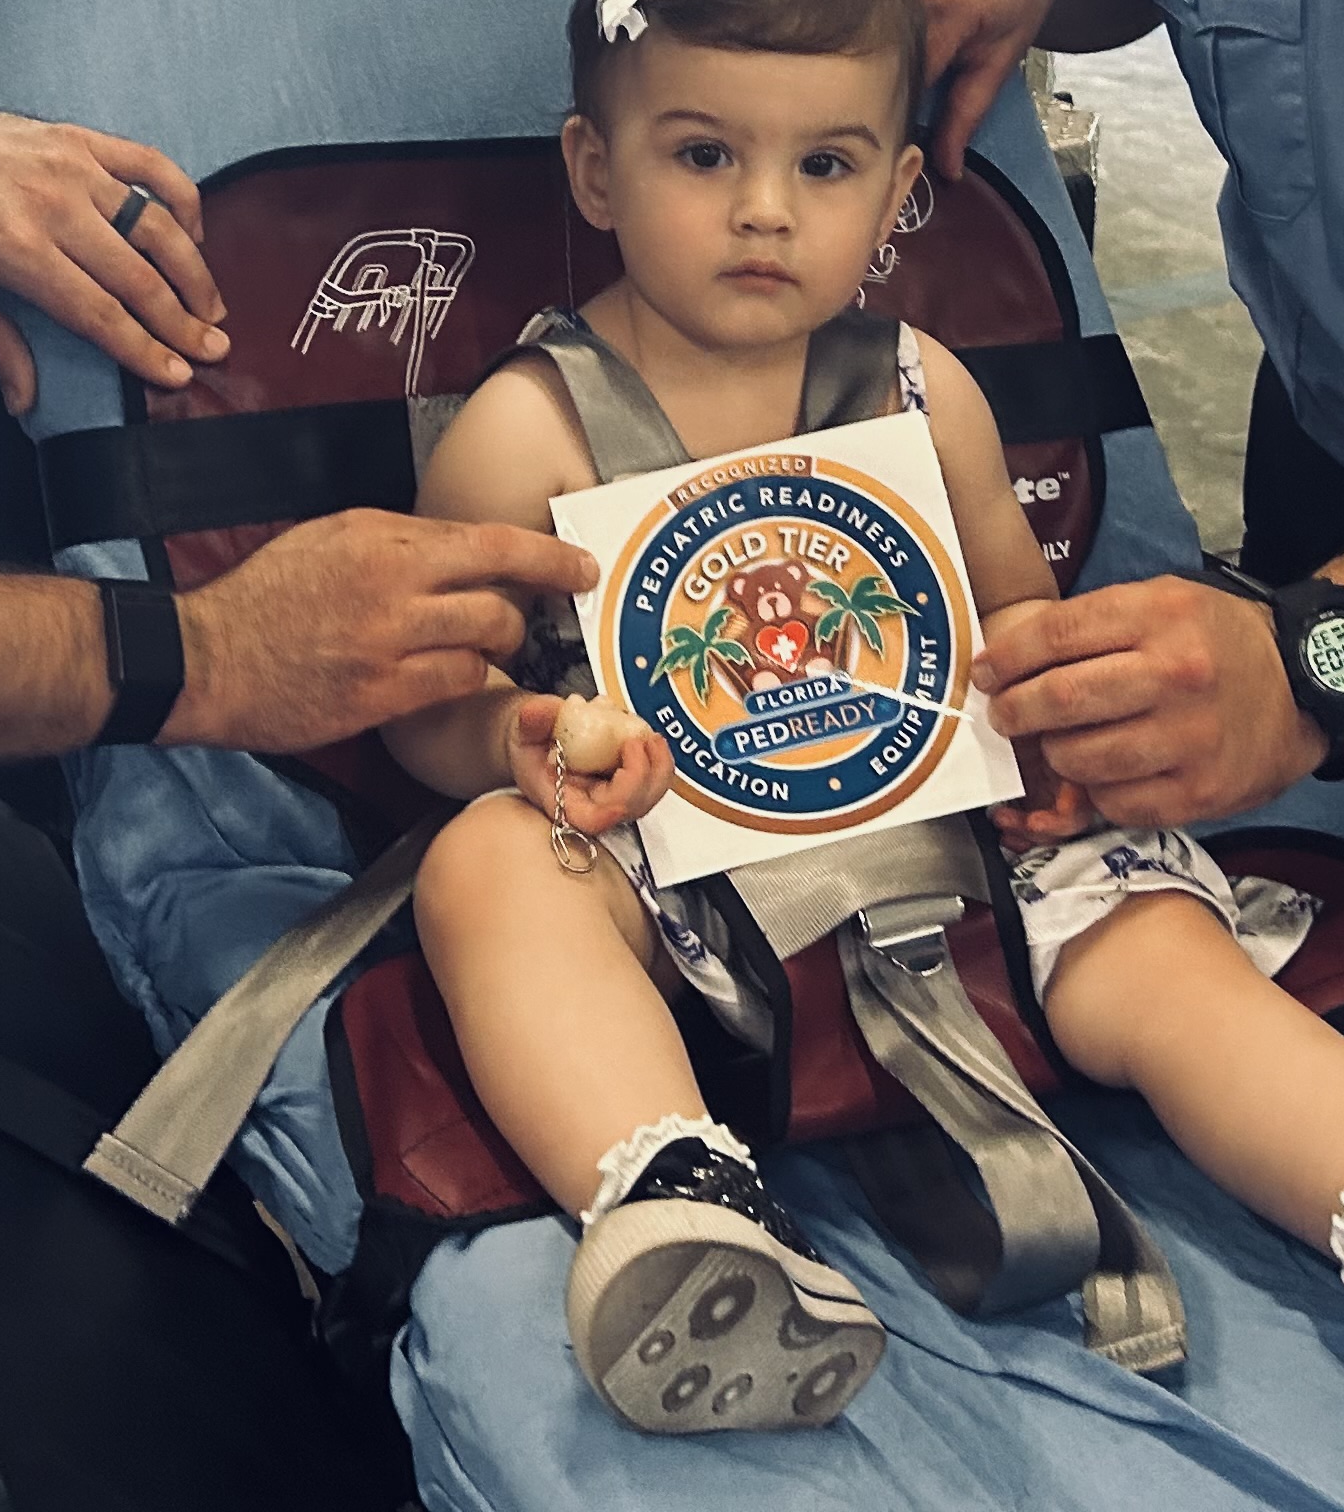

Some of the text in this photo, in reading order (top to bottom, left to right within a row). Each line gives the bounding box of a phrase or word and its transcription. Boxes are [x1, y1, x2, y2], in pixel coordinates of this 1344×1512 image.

[676, 456, 807, 503] RECOGNIZED
[635, 486, 910, 613] PEDIATRIC READINESS
[683, 527, 851, 602] GOLD TIER
[733, 697, 876, 754] PEDREADY
[755, 674, 843, 711] FLORIDA
[656, 704, 790, 802] EDUCATION
